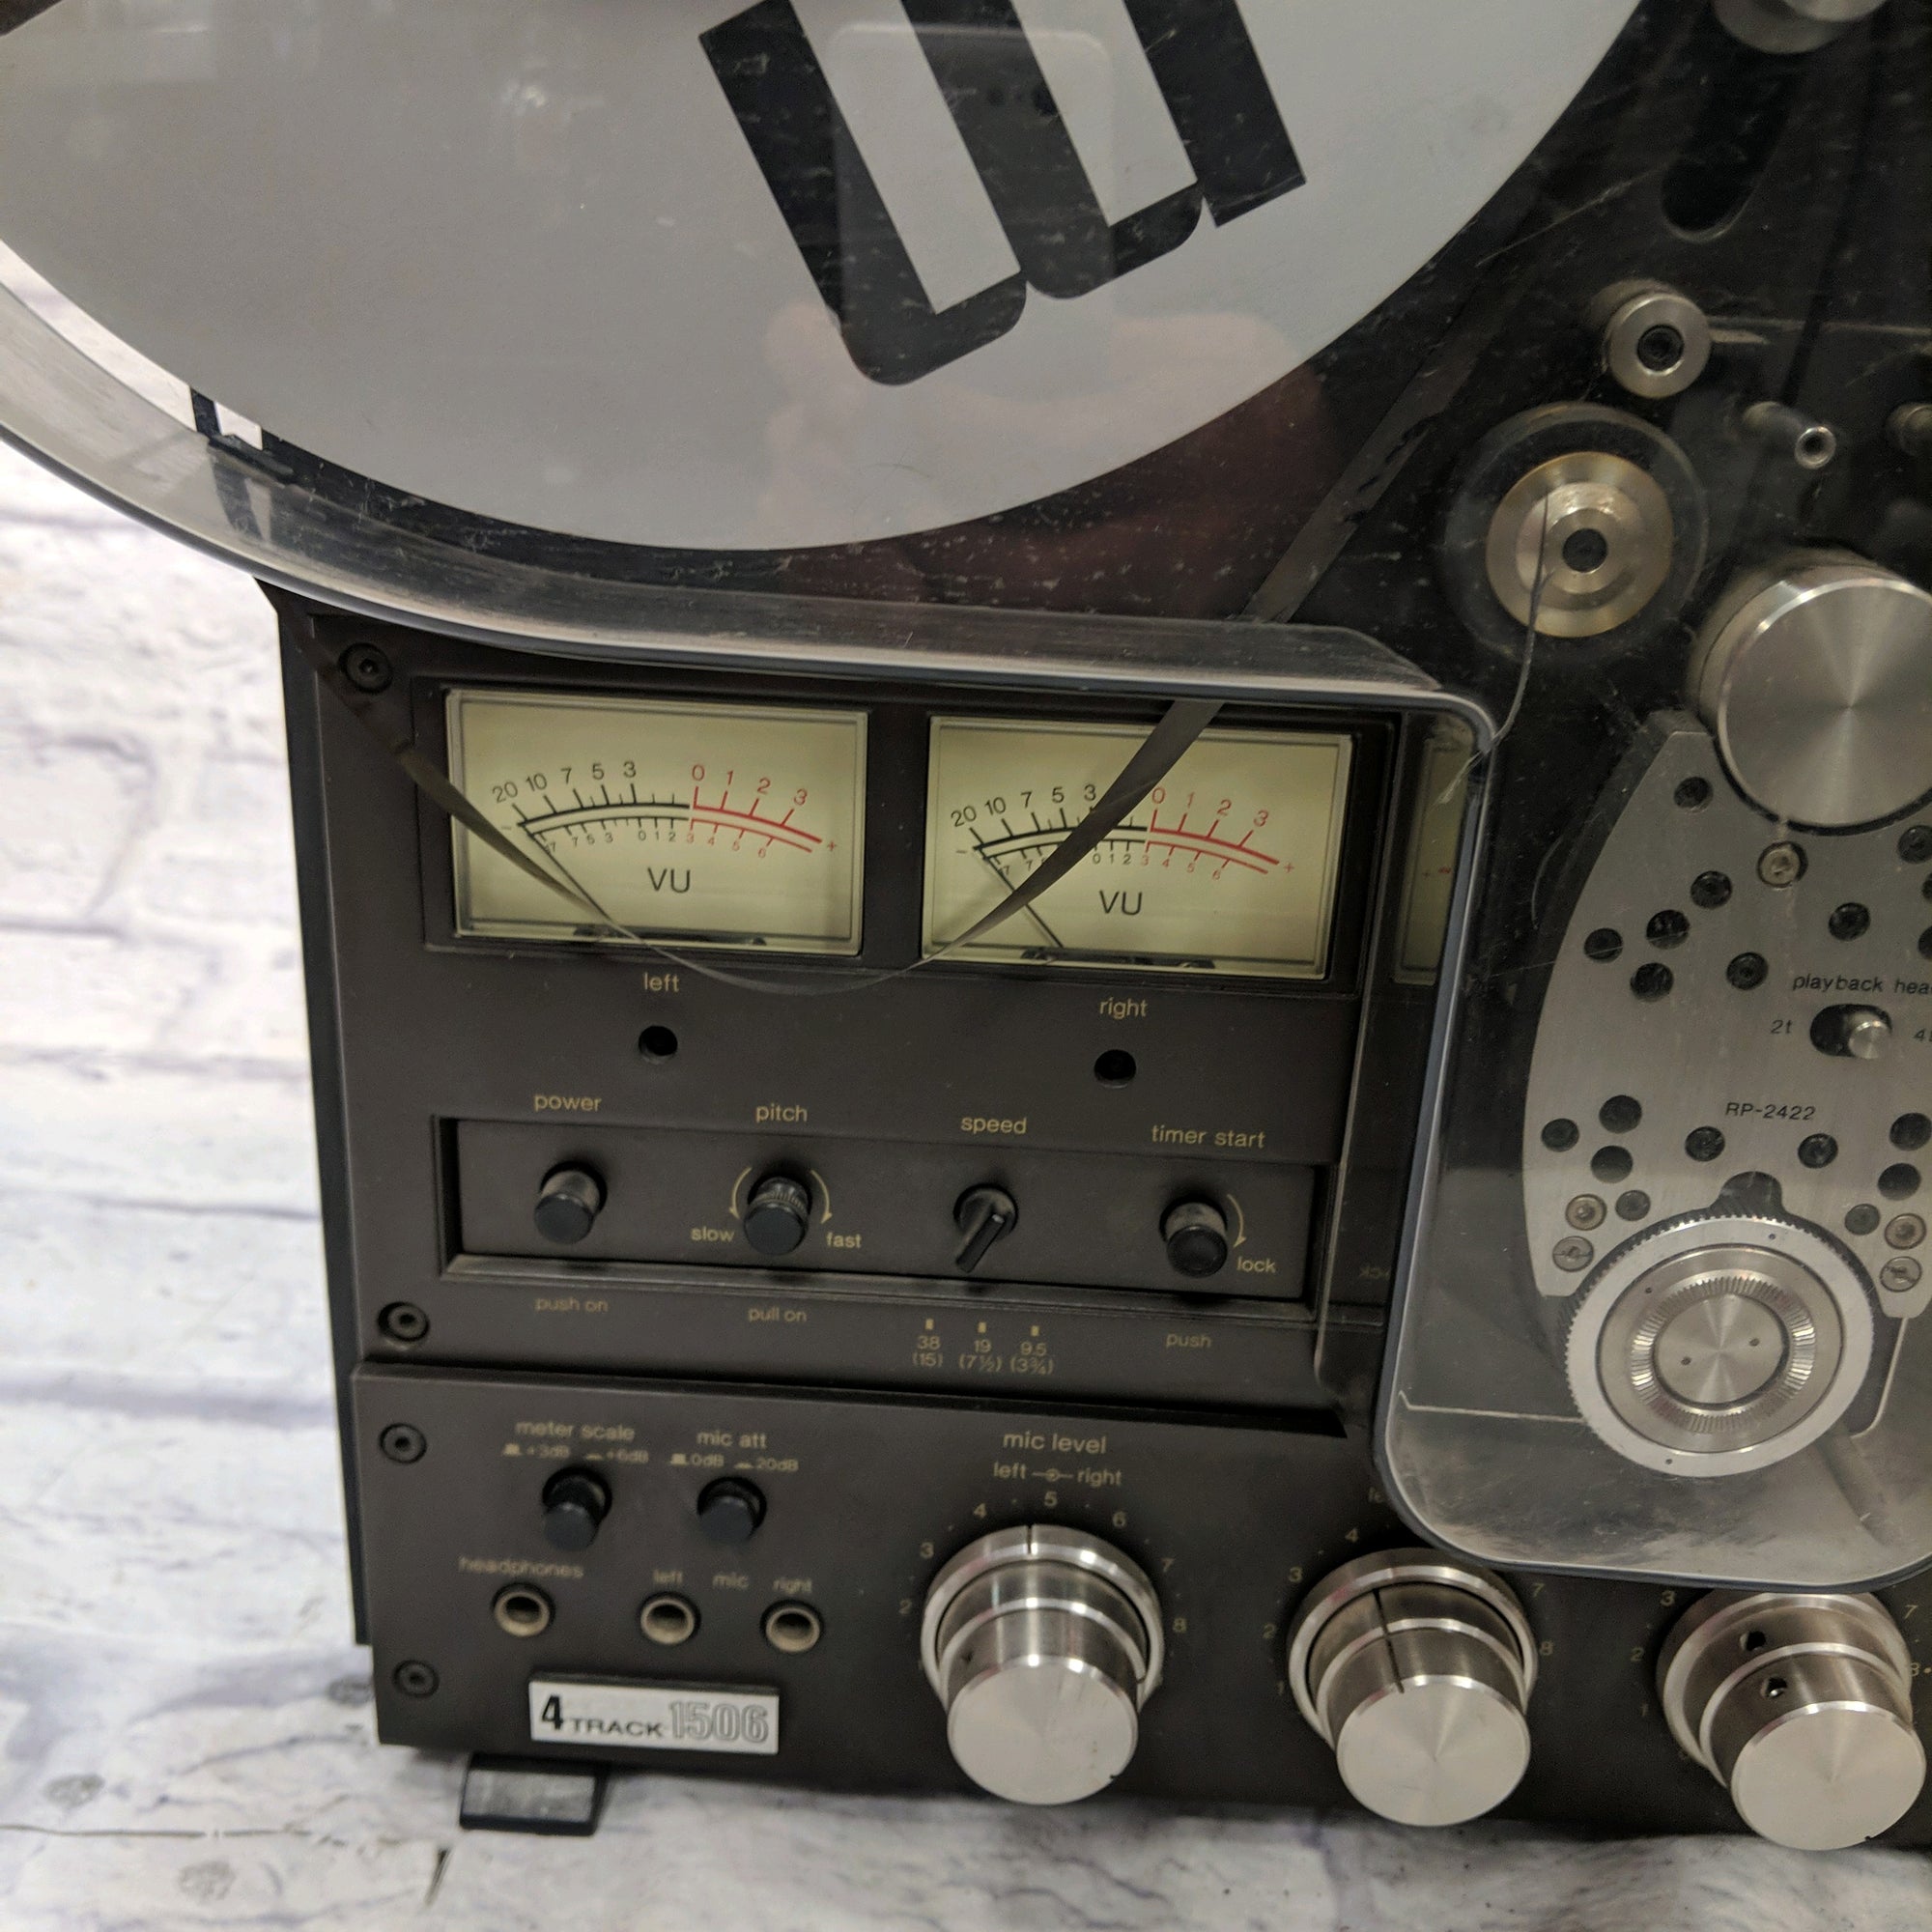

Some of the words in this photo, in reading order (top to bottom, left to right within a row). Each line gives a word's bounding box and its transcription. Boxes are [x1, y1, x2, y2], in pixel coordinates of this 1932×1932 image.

[492, 781, 519, 803] 20
[526, 773, 548, 792] 10
[560, 767, 572, 784] 7
[592, 762, 605, 781] 5
[623, 760, 637, 778] 3
[692, 764, 705, 781] 0
[726, 770, 734, 785] 1
[756, 777, 771, 794] 2
[793, 788, 808, 806] 3
[951, 805, 977, 828] 20
[984, 796, 1007, 815] 10
[1021, 790, 1033, 809] 7
[1052, 786, 1065, 804] 5
[1084, 783, 1096, 802] 3
[1151, 786, 1166, 805] 0
[1187, 791, 1195, 809] 1
[1216, 799, 1232, 816] 2
[1253, 810, 1269, 827] 3
[668, 832, 676, 842] 2
[687, 833, 695, 844] 3
[707, 836, 715, 846] 4
[1122, 854, 1131, 865] 2
[1141, 855, 1150, 867] 3
[1162, 858, 1170, 868] 4
[1187, 863, 1196, 873] 5
[1211, 869, 1221, 880] 6
[647, 867, 692, 894] VU
[1099, 889, 1143, 916] VU
[642, 972, 680, 993] left
[1792, 973, 1883, 992] playback
[1894, 978, 1932, 994] hea
[1098, 997, 1149, 1018] right
[1770, 1019, 1793, 1035] 2t
[533, 1094, 602, 1112] power
[755, 1103, 808, 1123] pitch
[1725, 1101, 1816, 1121] RP-2422
[960, 1115, 1028, 1135] speed
[1151, 1124, 1207, 1145] timer
[1214, 1129, 1266, 1149] start
[691, 1225, 734, 1243] slow
[826, 1232, 862, 1249] fast
[1236, 1256, 1276, 1273] lock
[534, 1296, 579, 1312] push
[584, 1298, 609, 1313] on
[748, 1306, 780, 1322] pull
[784, 1309, 807, 1322] on
[918, 1335, 941, 1350] 38
[974, 1339, 992, 1352] 19
[1166, 1331, 1211, 1350] push
[515, 1421, 574, 1436] meter
[582, 1424, 635, 1441] scale
[696, 1431, 733, 1447] mic
[739, 1433, 767, 1449] att
[1003, 1432, 1045, 1451] mic
[1052, 1433, 1107, 1455] level
[993, 1462, 1027, 1480] left
[1077, 1467, 1122, 1487] right
[974, 1503, 987, 1519] 4
[1044, 1492, 1058, 1507] 5
[1113, 1512, 1126, 1527] 6
[1345, 1528, 1358, 1543] 4
[459, 1555, 584, 1579] headphones
[921, 1543, 934, 1558] 3
[1162, 1557, 1175, 1571] 7
[653, 1570, 683, 1585] left
[712, 1574, 750, 1590] mic
[774, 1577, 812, 1595] right
[1289, 1567, 1302, 1583] 3
[1532, 1583, 1545, 1597] 7
[899, 1599, 911, 1614] 2
[1660, 1591, 1676, 1606] 3
[1904, 1605, 1918, 1619] 7
[1263, 1624, 1275, 1639] 2
[1631, 1648, 1644, 1662] 2
[541, 1693, 564, 1730] 4
[567, 1717, 664, 1738] TRACK
[668, 1700, 770, 1743] 1506
